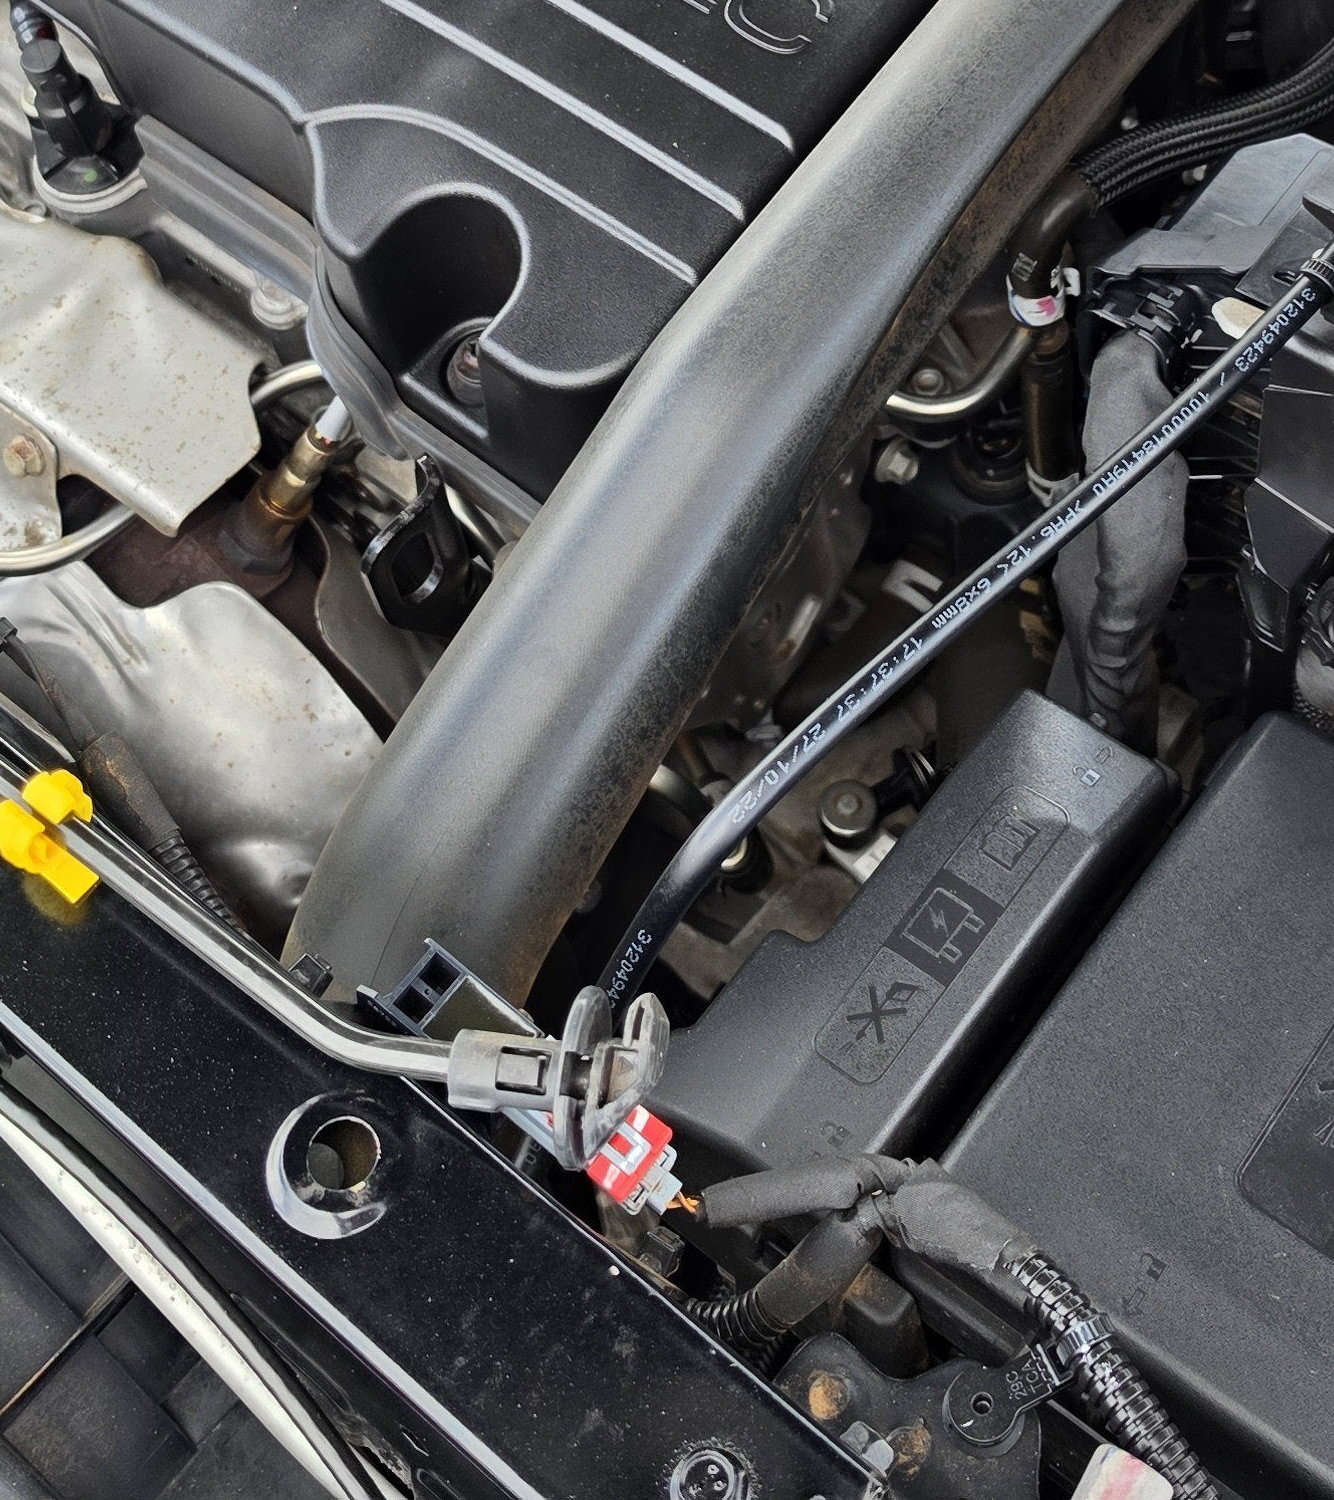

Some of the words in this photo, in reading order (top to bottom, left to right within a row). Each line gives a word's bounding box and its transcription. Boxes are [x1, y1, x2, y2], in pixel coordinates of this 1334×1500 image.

[1232, 286, 1317, 373] 312049423
[930, 575, 992, 632] 6x8mm
[831, 632, 925, 722] 17:37:37
[728, 724, 827, 825] 27/10/22
[1021, 1359, 1044, 1393] TCA
